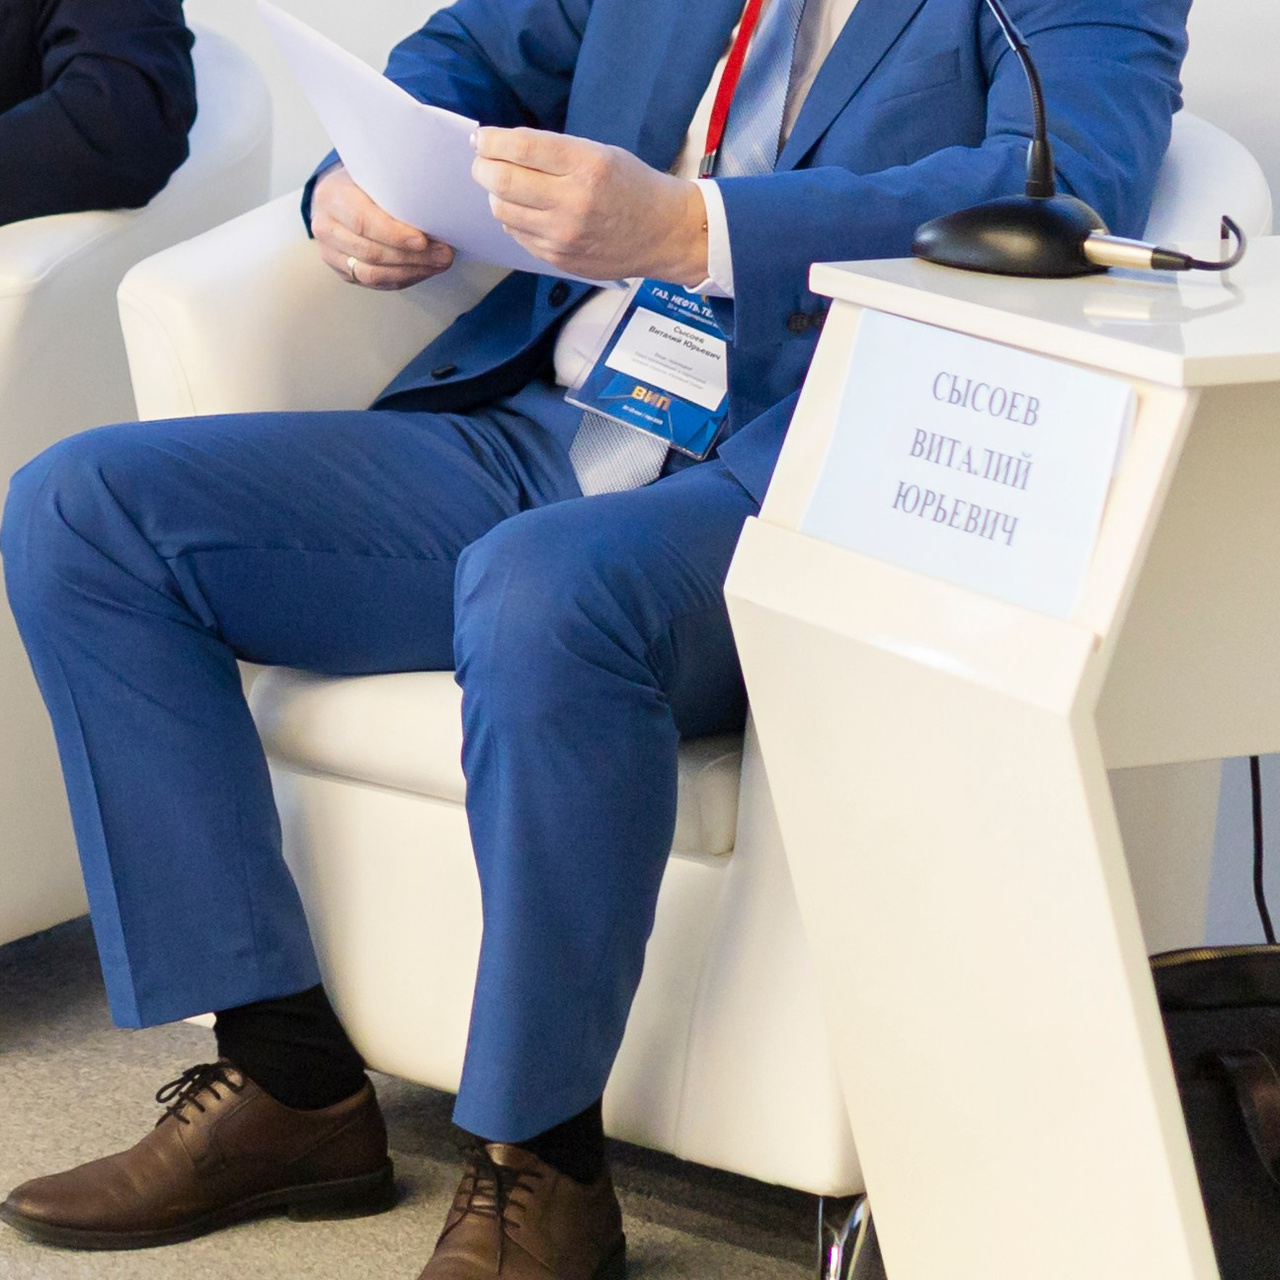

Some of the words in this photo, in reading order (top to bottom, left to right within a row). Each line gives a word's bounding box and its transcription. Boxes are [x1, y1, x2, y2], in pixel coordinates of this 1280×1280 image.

[648, 325, 682, 343] Виталий
[683, 339, 721, 360] Юрьевич
[673, 325, 705, 344] Сысоев
[632, 385, 671, 411] ВИП
[932, 371, 1040, 426] СЫСОЕВ
[909, 428, 1034, 491] ВИТАЛИЙ
[891, 480, 1020, 547] ЮРЬЕВИЧ
